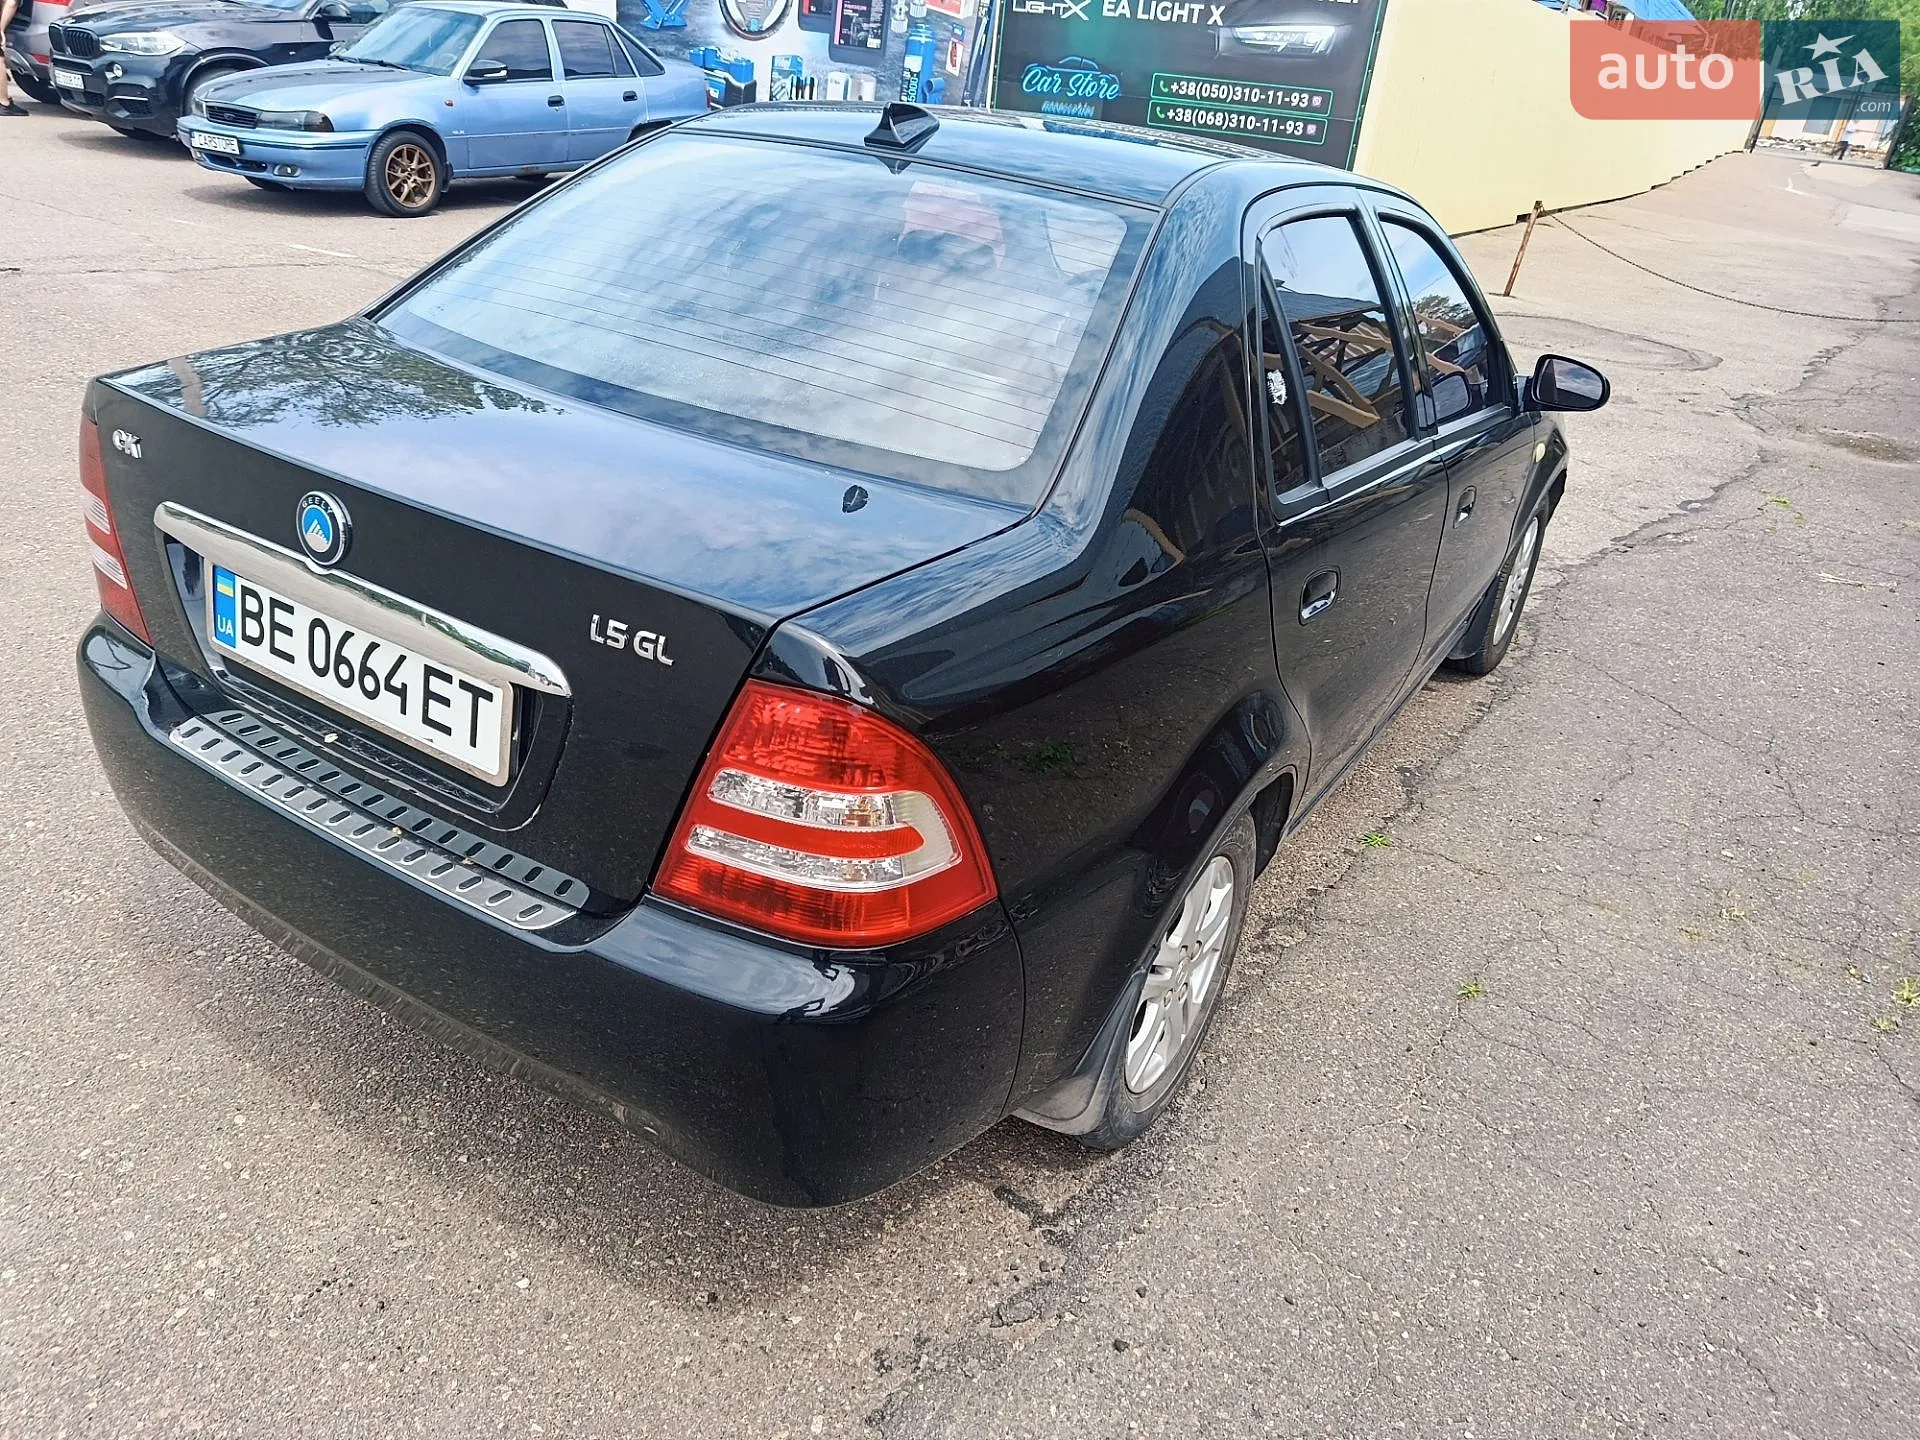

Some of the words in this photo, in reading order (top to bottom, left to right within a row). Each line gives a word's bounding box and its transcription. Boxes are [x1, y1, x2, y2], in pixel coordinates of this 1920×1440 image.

[1102, 0, 1131, 19] EA
[1137, 1, 1205, 24] LIGHT
[1206, 5, 1226, 26] X
[1022, 68, 1062, 94] Car
[1066, 73, 1119, 100] Store
[1170, 80, 1310, 108] +38(050)310-11-93
[1166, 107, 1304, 136] +38(068)310-11-93
[217, 617, 234, 638] UA
[633, 630, 674, 666] GL
[240, 584, 295, 665] BE
[307, 617, 407, 716] 0664
[421, 663, 494, 748] ET
